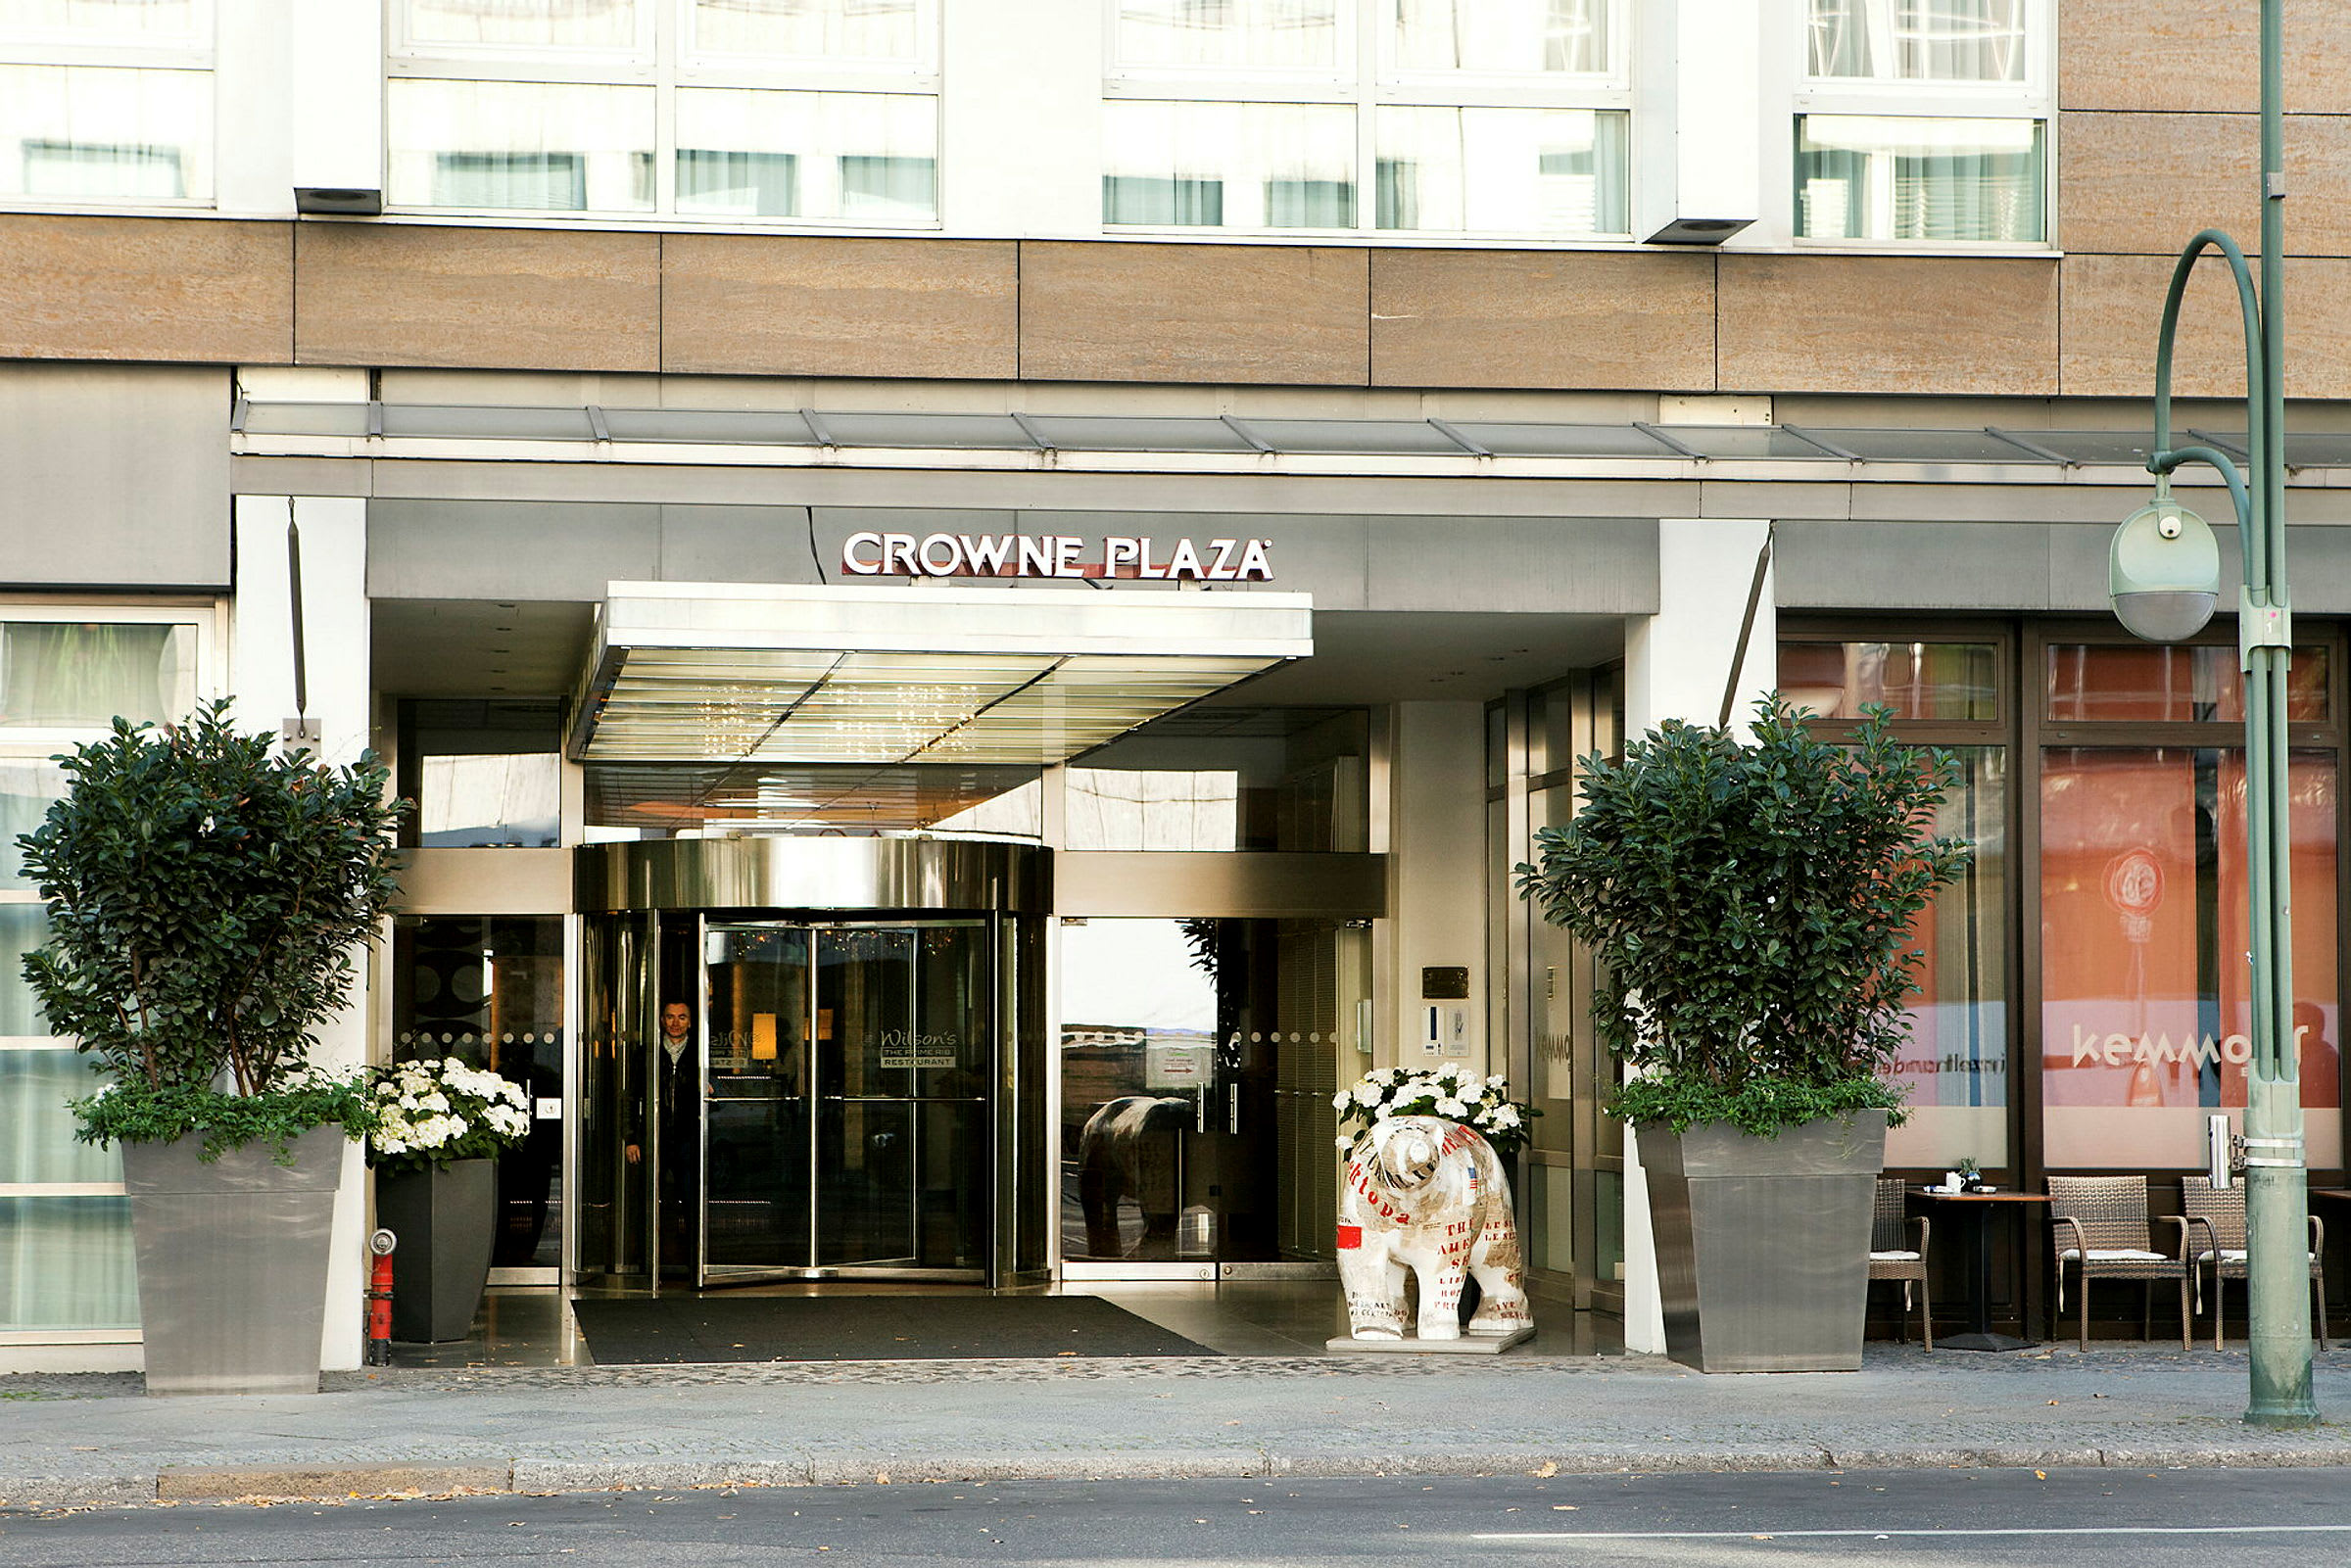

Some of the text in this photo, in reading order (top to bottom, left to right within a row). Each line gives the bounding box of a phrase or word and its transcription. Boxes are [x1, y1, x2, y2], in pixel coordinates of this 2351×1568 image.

[842, 532, 1274, 581] CROWNE PLAZA
[881, 1028, 957, 1047] Wilson's
